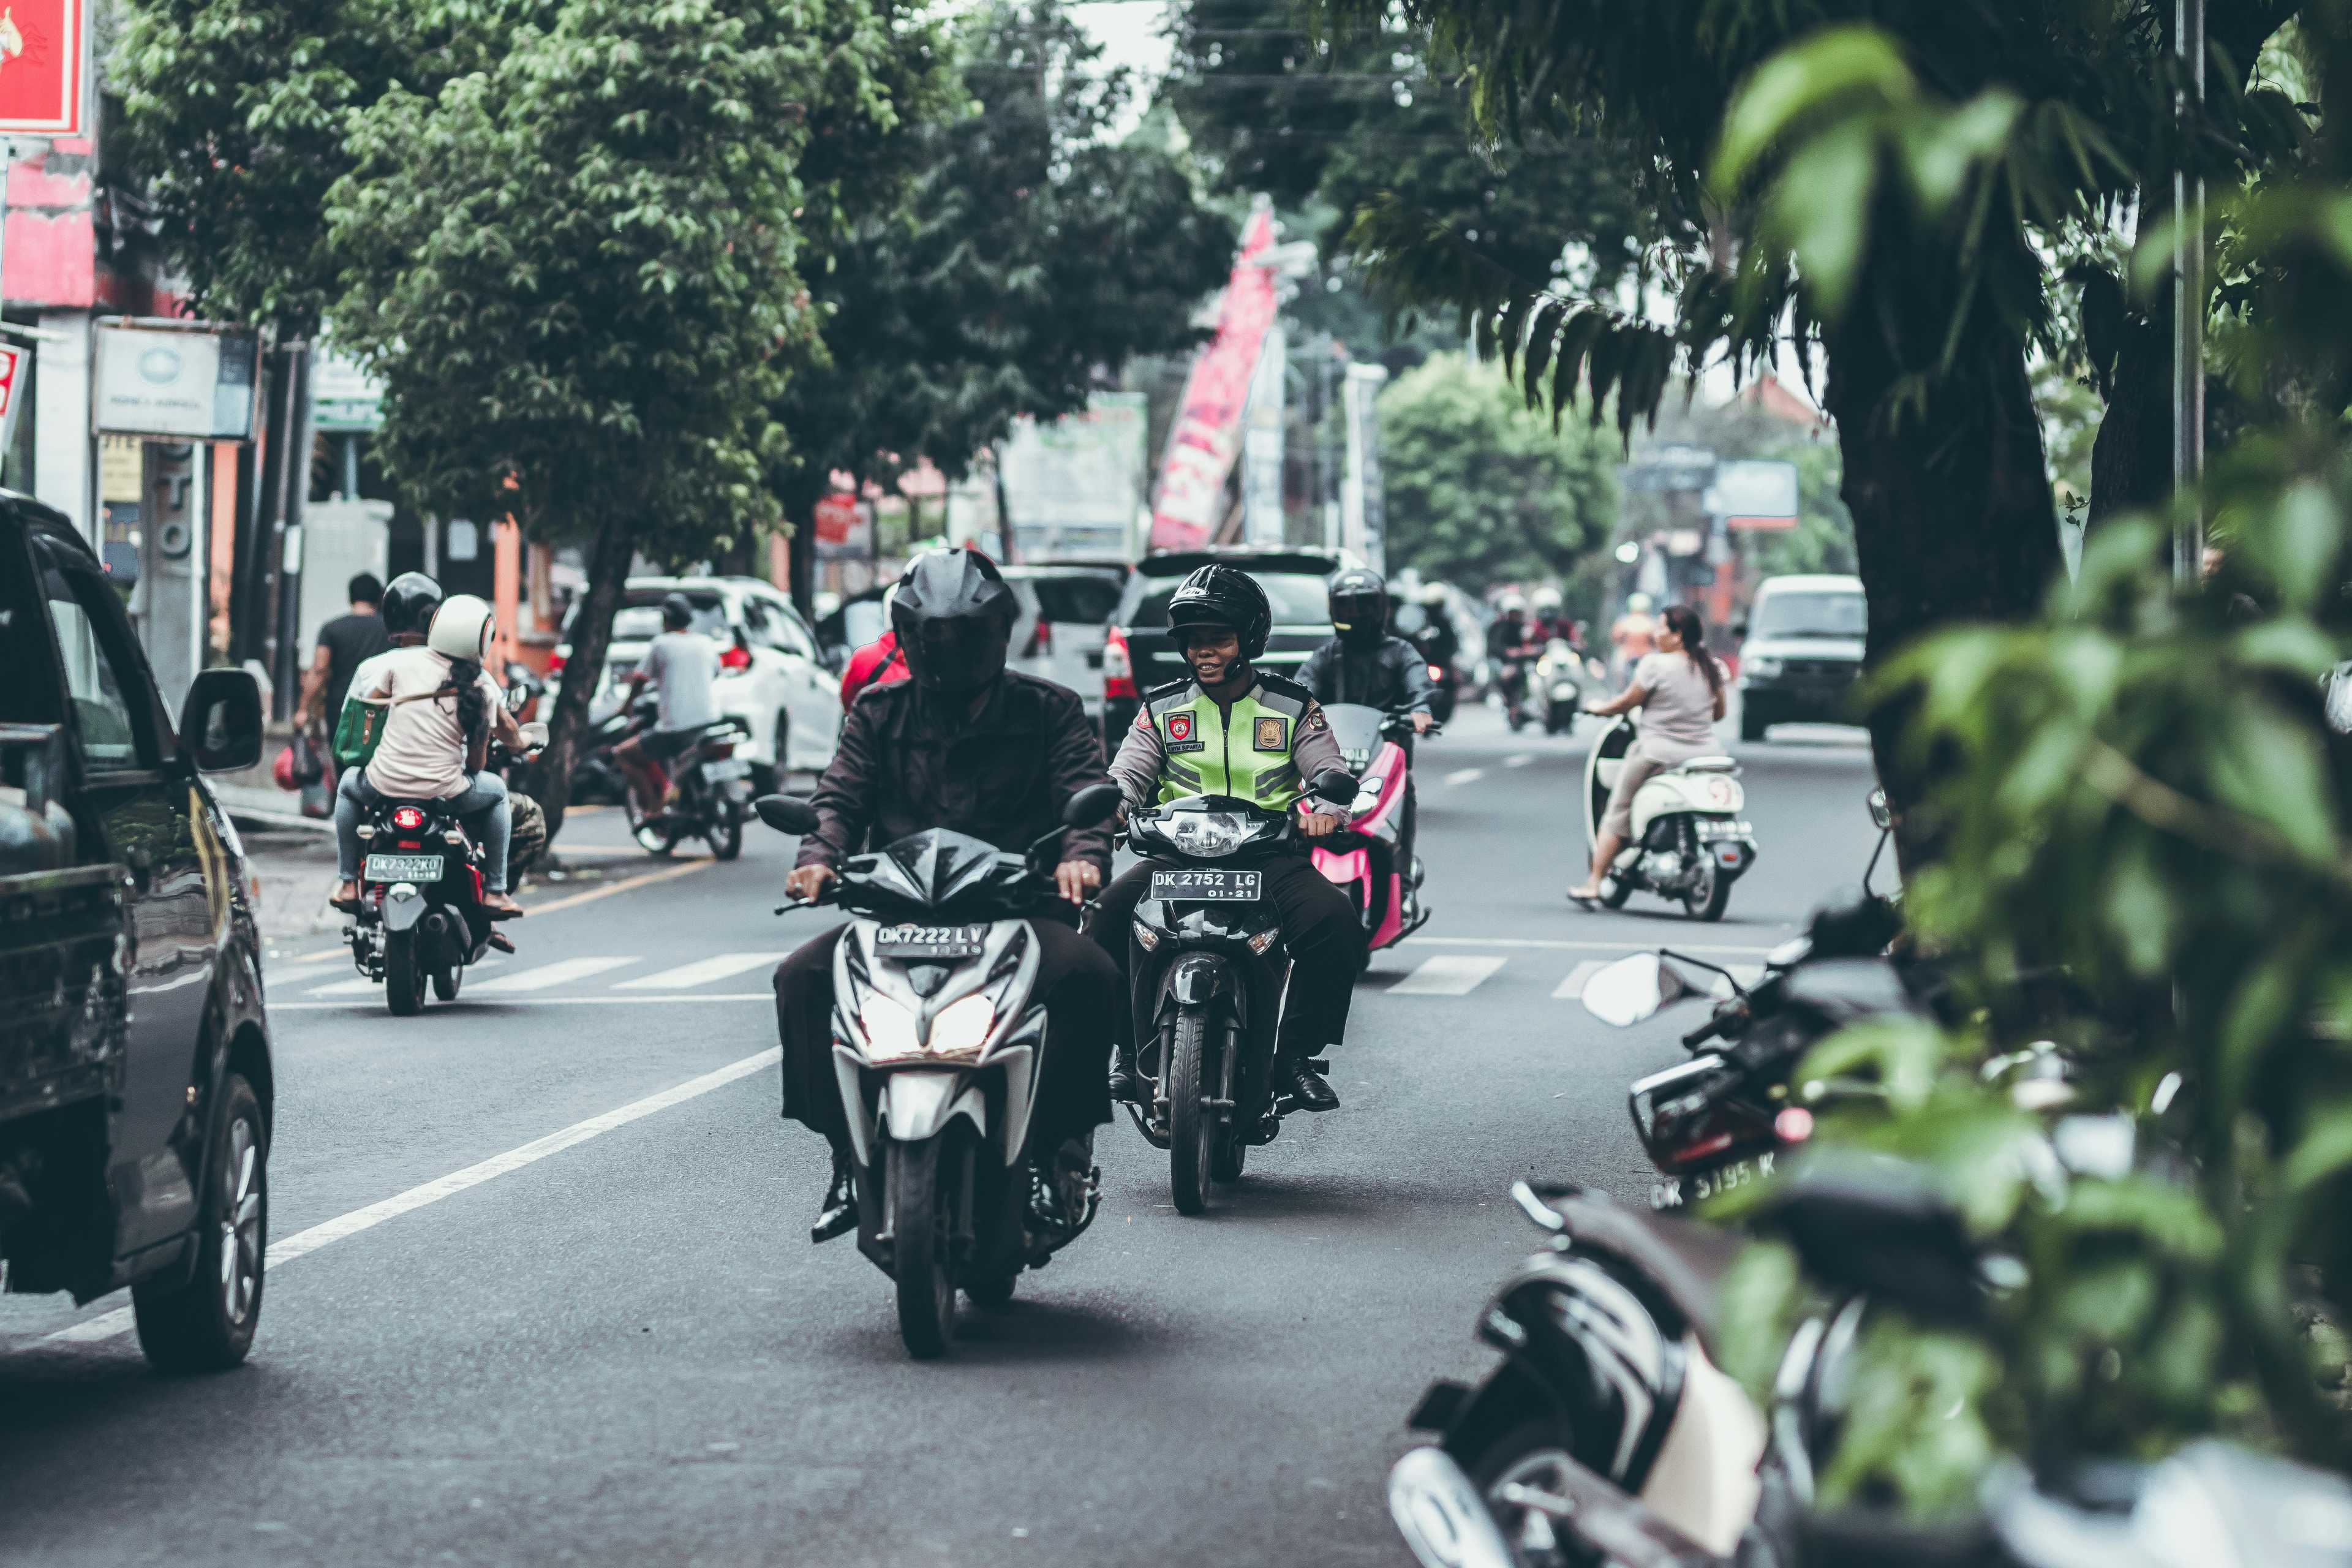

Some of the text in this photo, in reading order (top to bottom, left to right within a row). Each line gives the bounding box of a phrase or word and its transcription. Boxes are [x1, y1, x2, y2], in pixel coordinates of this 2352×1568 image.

[1155, 873, 1255, 886] DK 2752 LG
